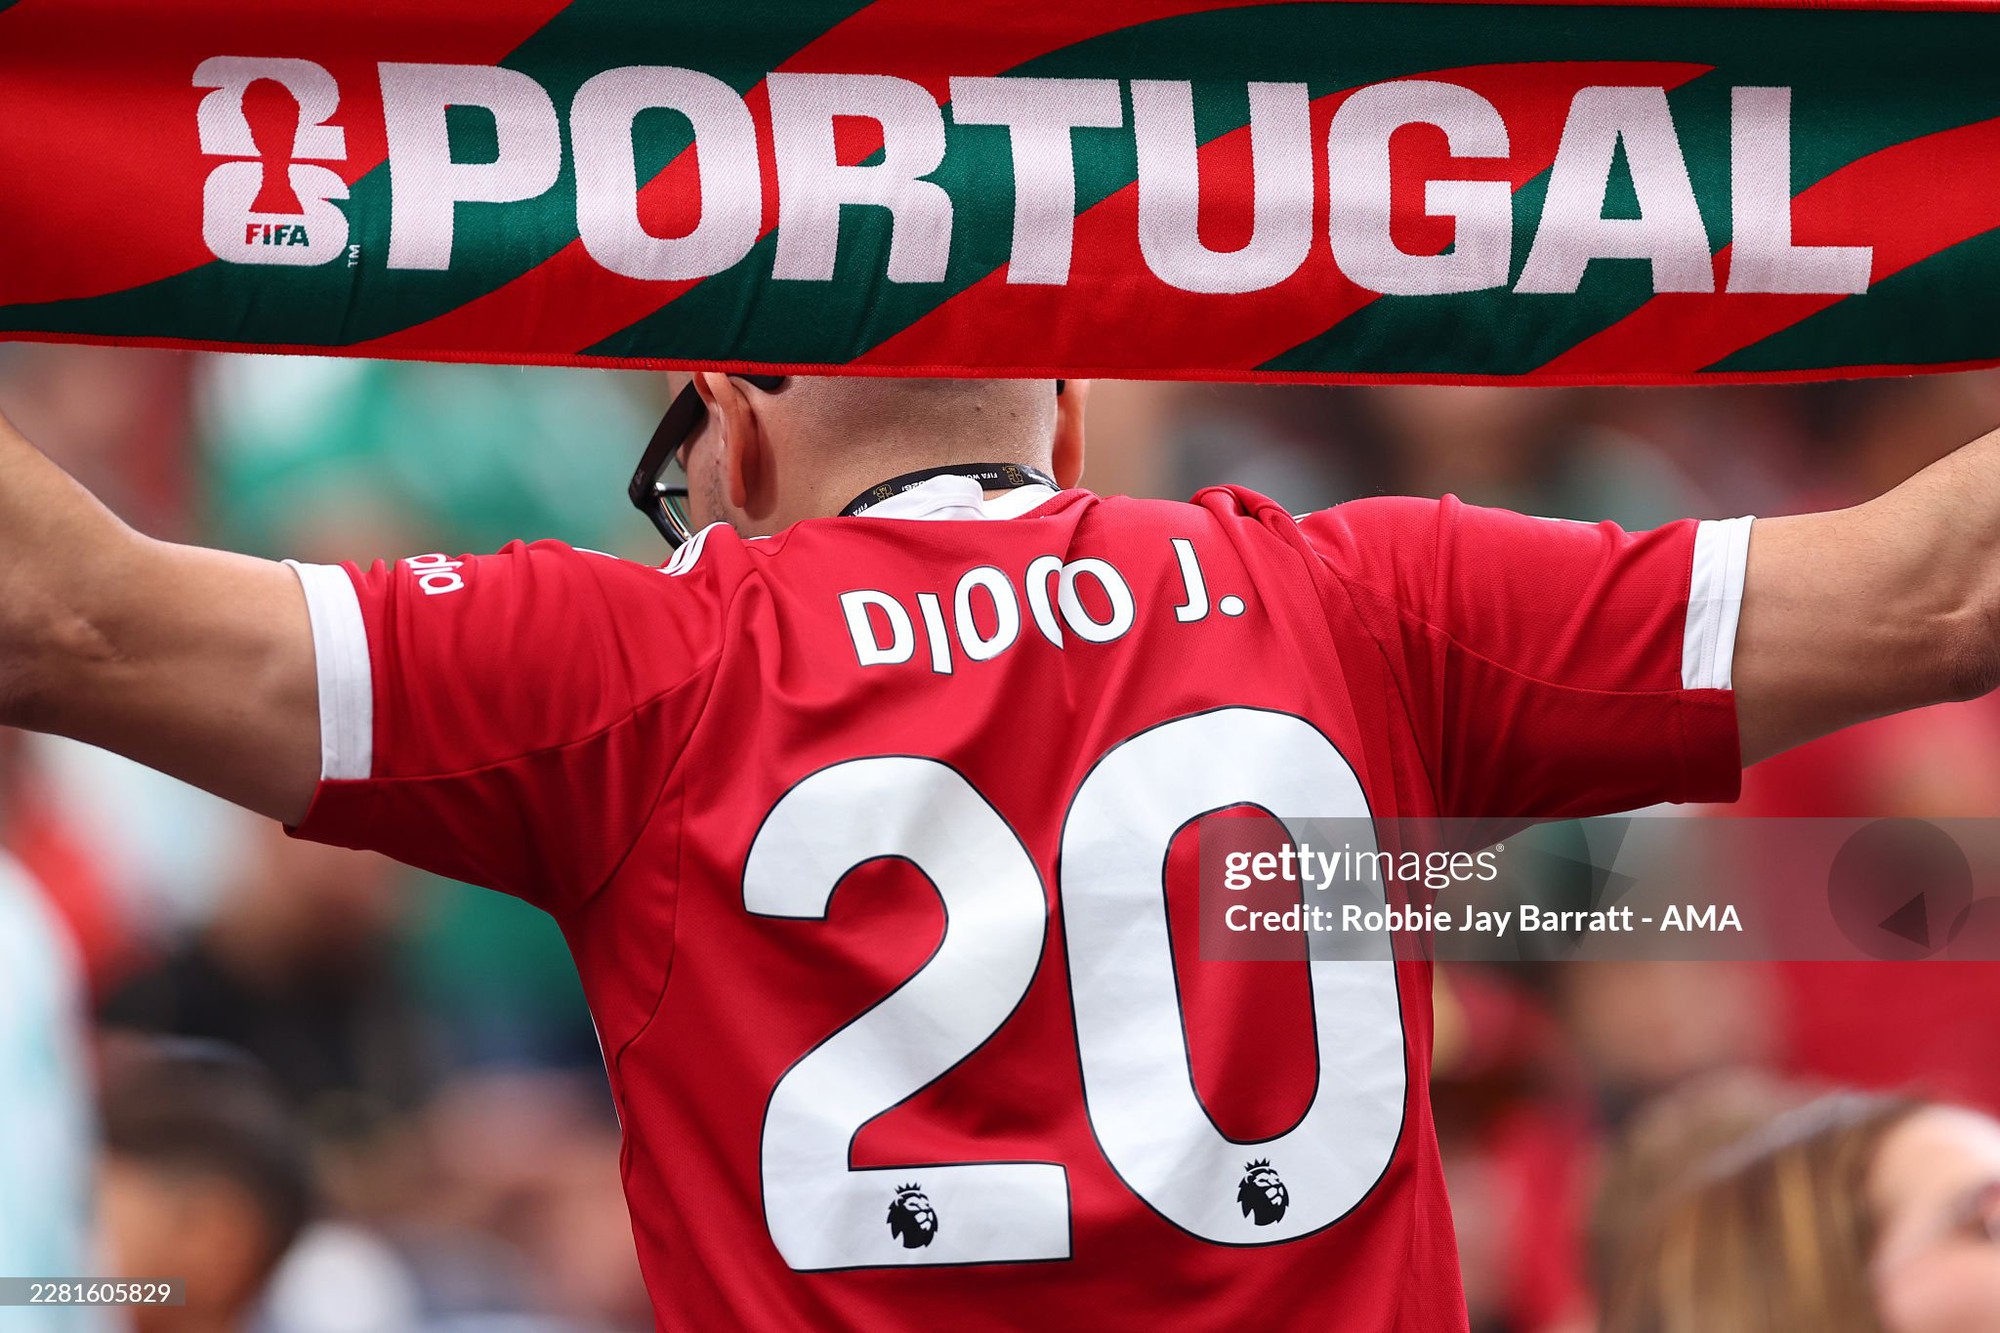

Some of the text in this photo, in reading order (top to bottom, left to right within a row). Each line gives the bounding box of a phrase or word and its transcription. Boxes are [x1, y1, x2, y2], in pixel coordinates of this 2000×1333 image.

[245, 223, 310, 247] FIFA
[377, 62, 1874, 297] PORTUGAL
[1169, 537, 1247, 624] J.
[741, 705, 1409, 1273] 20
